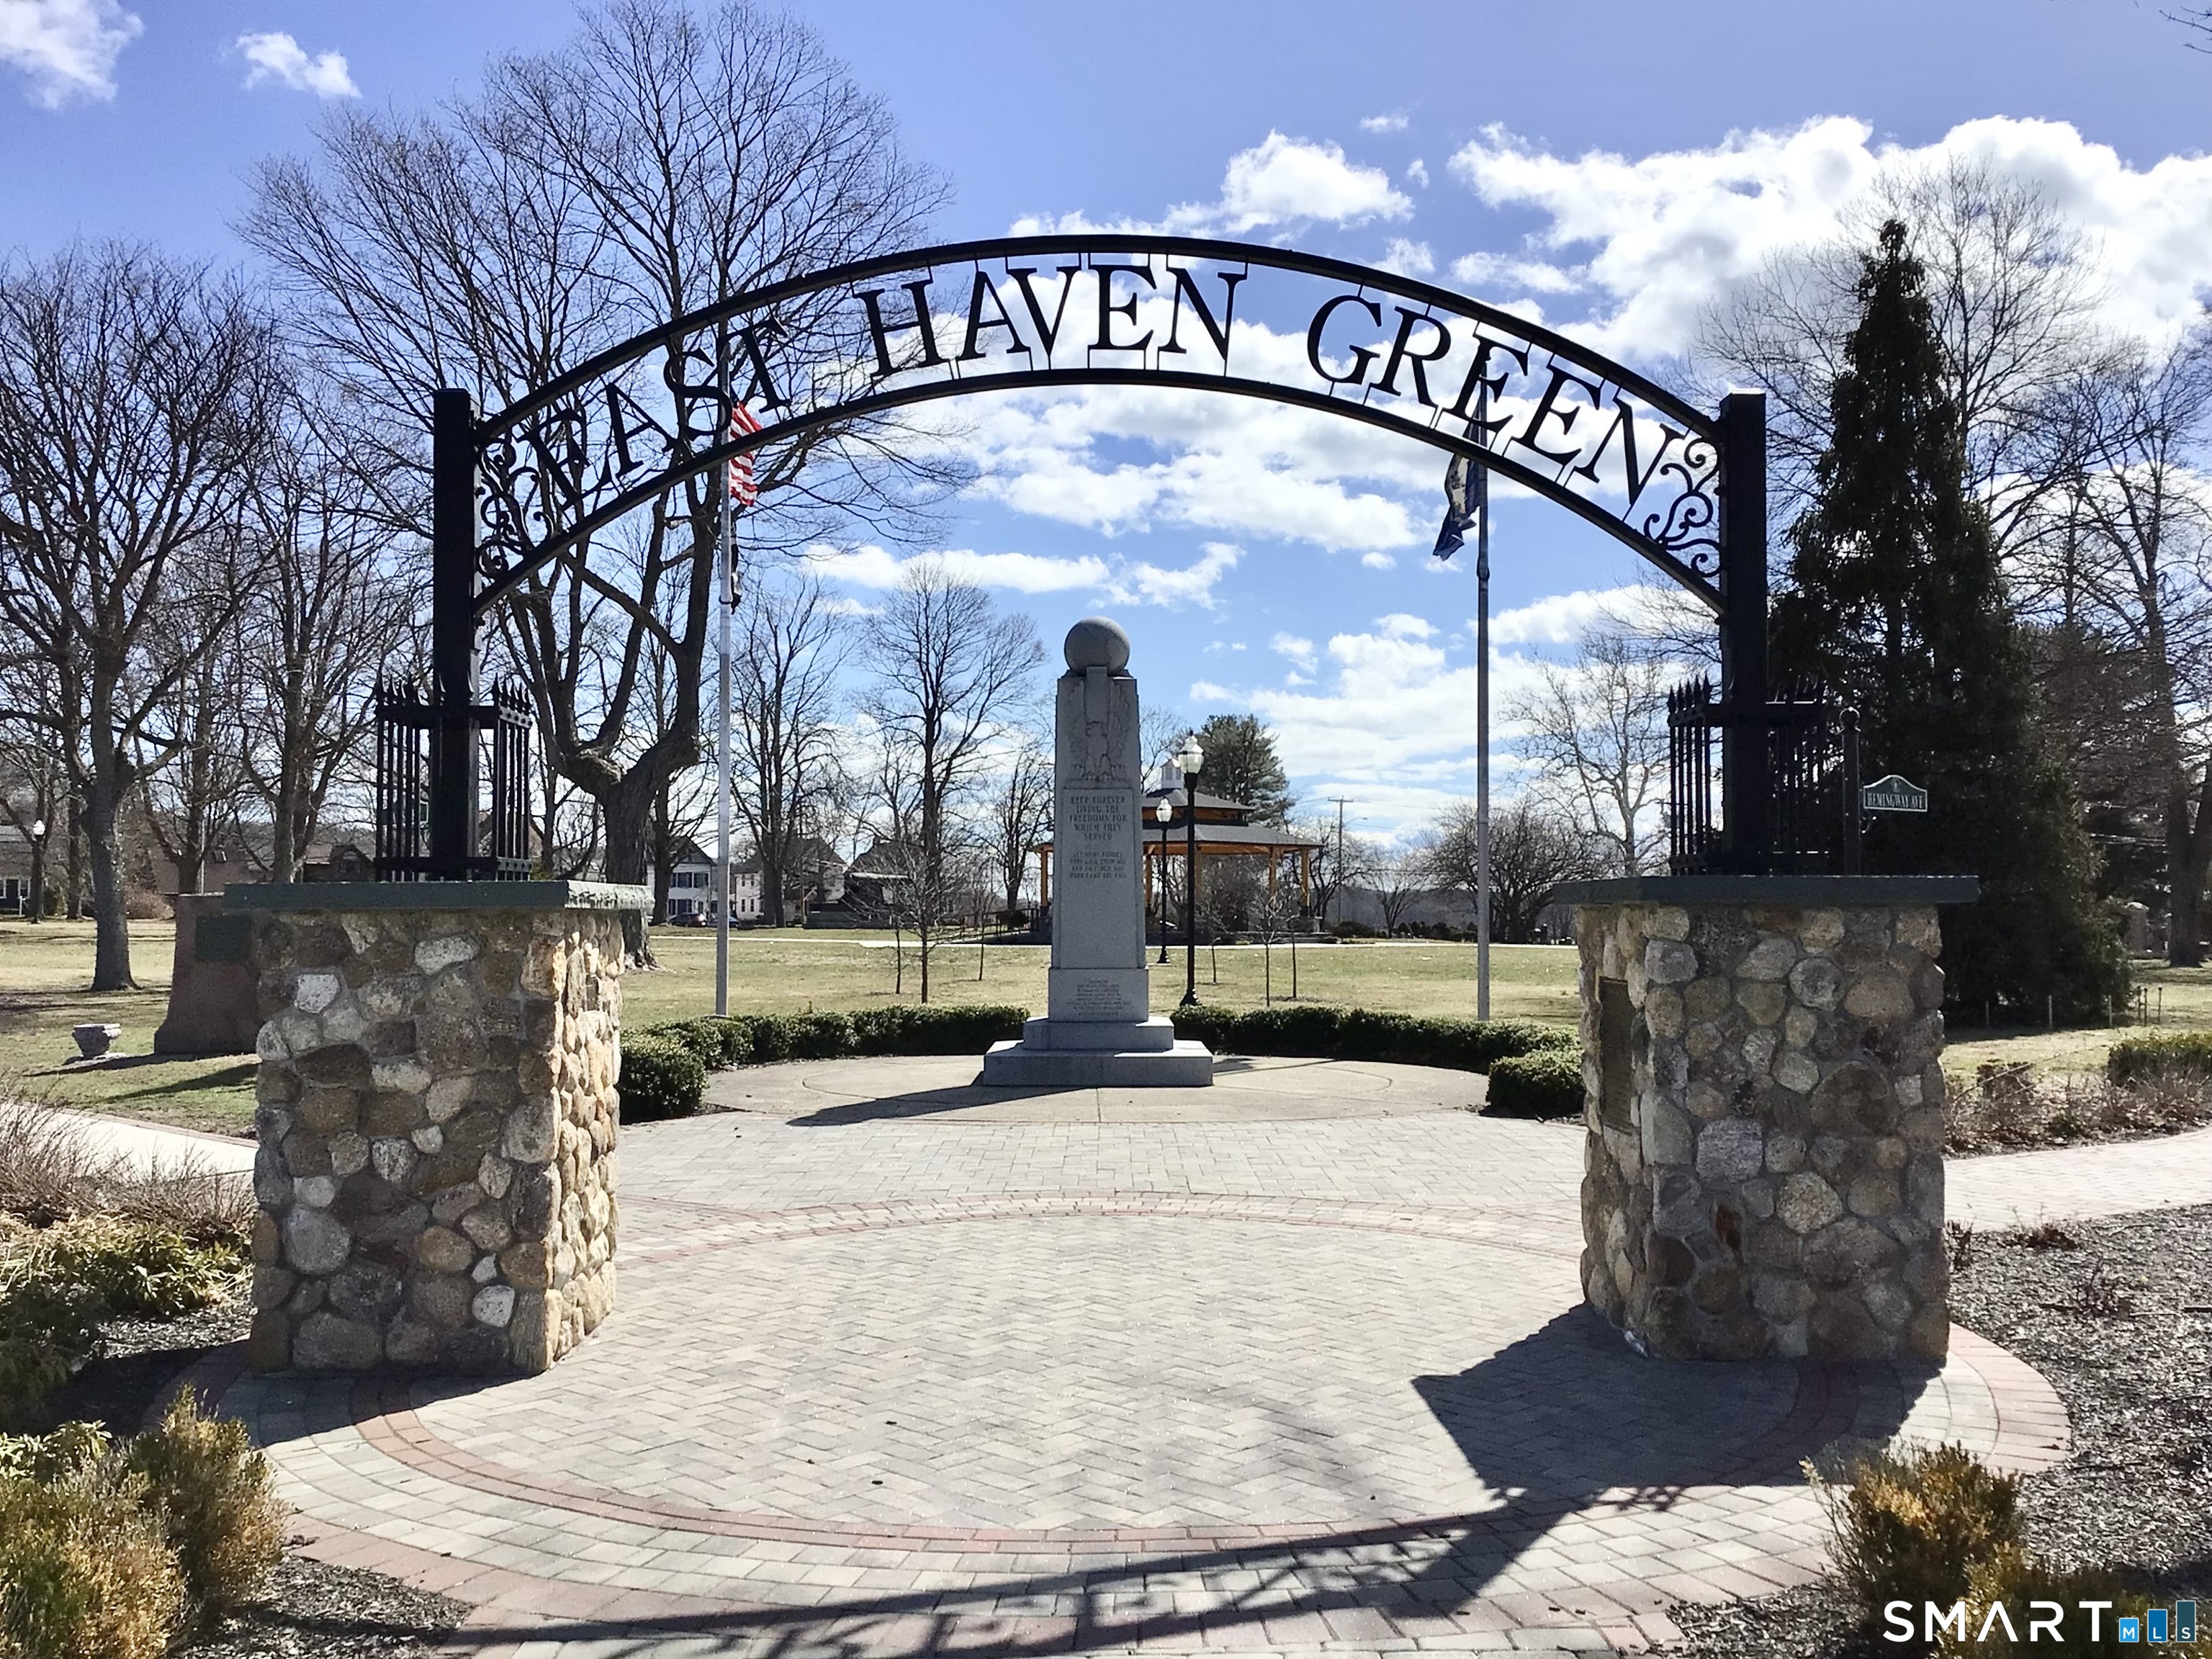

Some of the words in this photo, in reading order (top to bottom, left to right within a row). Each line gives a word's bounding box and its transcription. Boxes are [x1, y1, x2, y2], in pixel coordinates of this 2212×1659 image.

[516, 315, 791, 511] EAST
[852, 264, 1247, 377] HAVEN
[1307, 295, 1690, 505] GREEN
[1070, 796, 1089, 804] KEEP
[1092, 796, 1125, 804] FOREVER
[1867, 793, 1910, 808] HEMINGWAY
[1910, 795, 1924, 809] AVE
[1076, 805, 1102, 814] LIVING
[1105, 805, 1119, 814] THE
[1074, 823, 1100, 832] WHICH
[1104, 823, 1121, 832] THEY
[1084, 832, 1112, 841] SERVED
